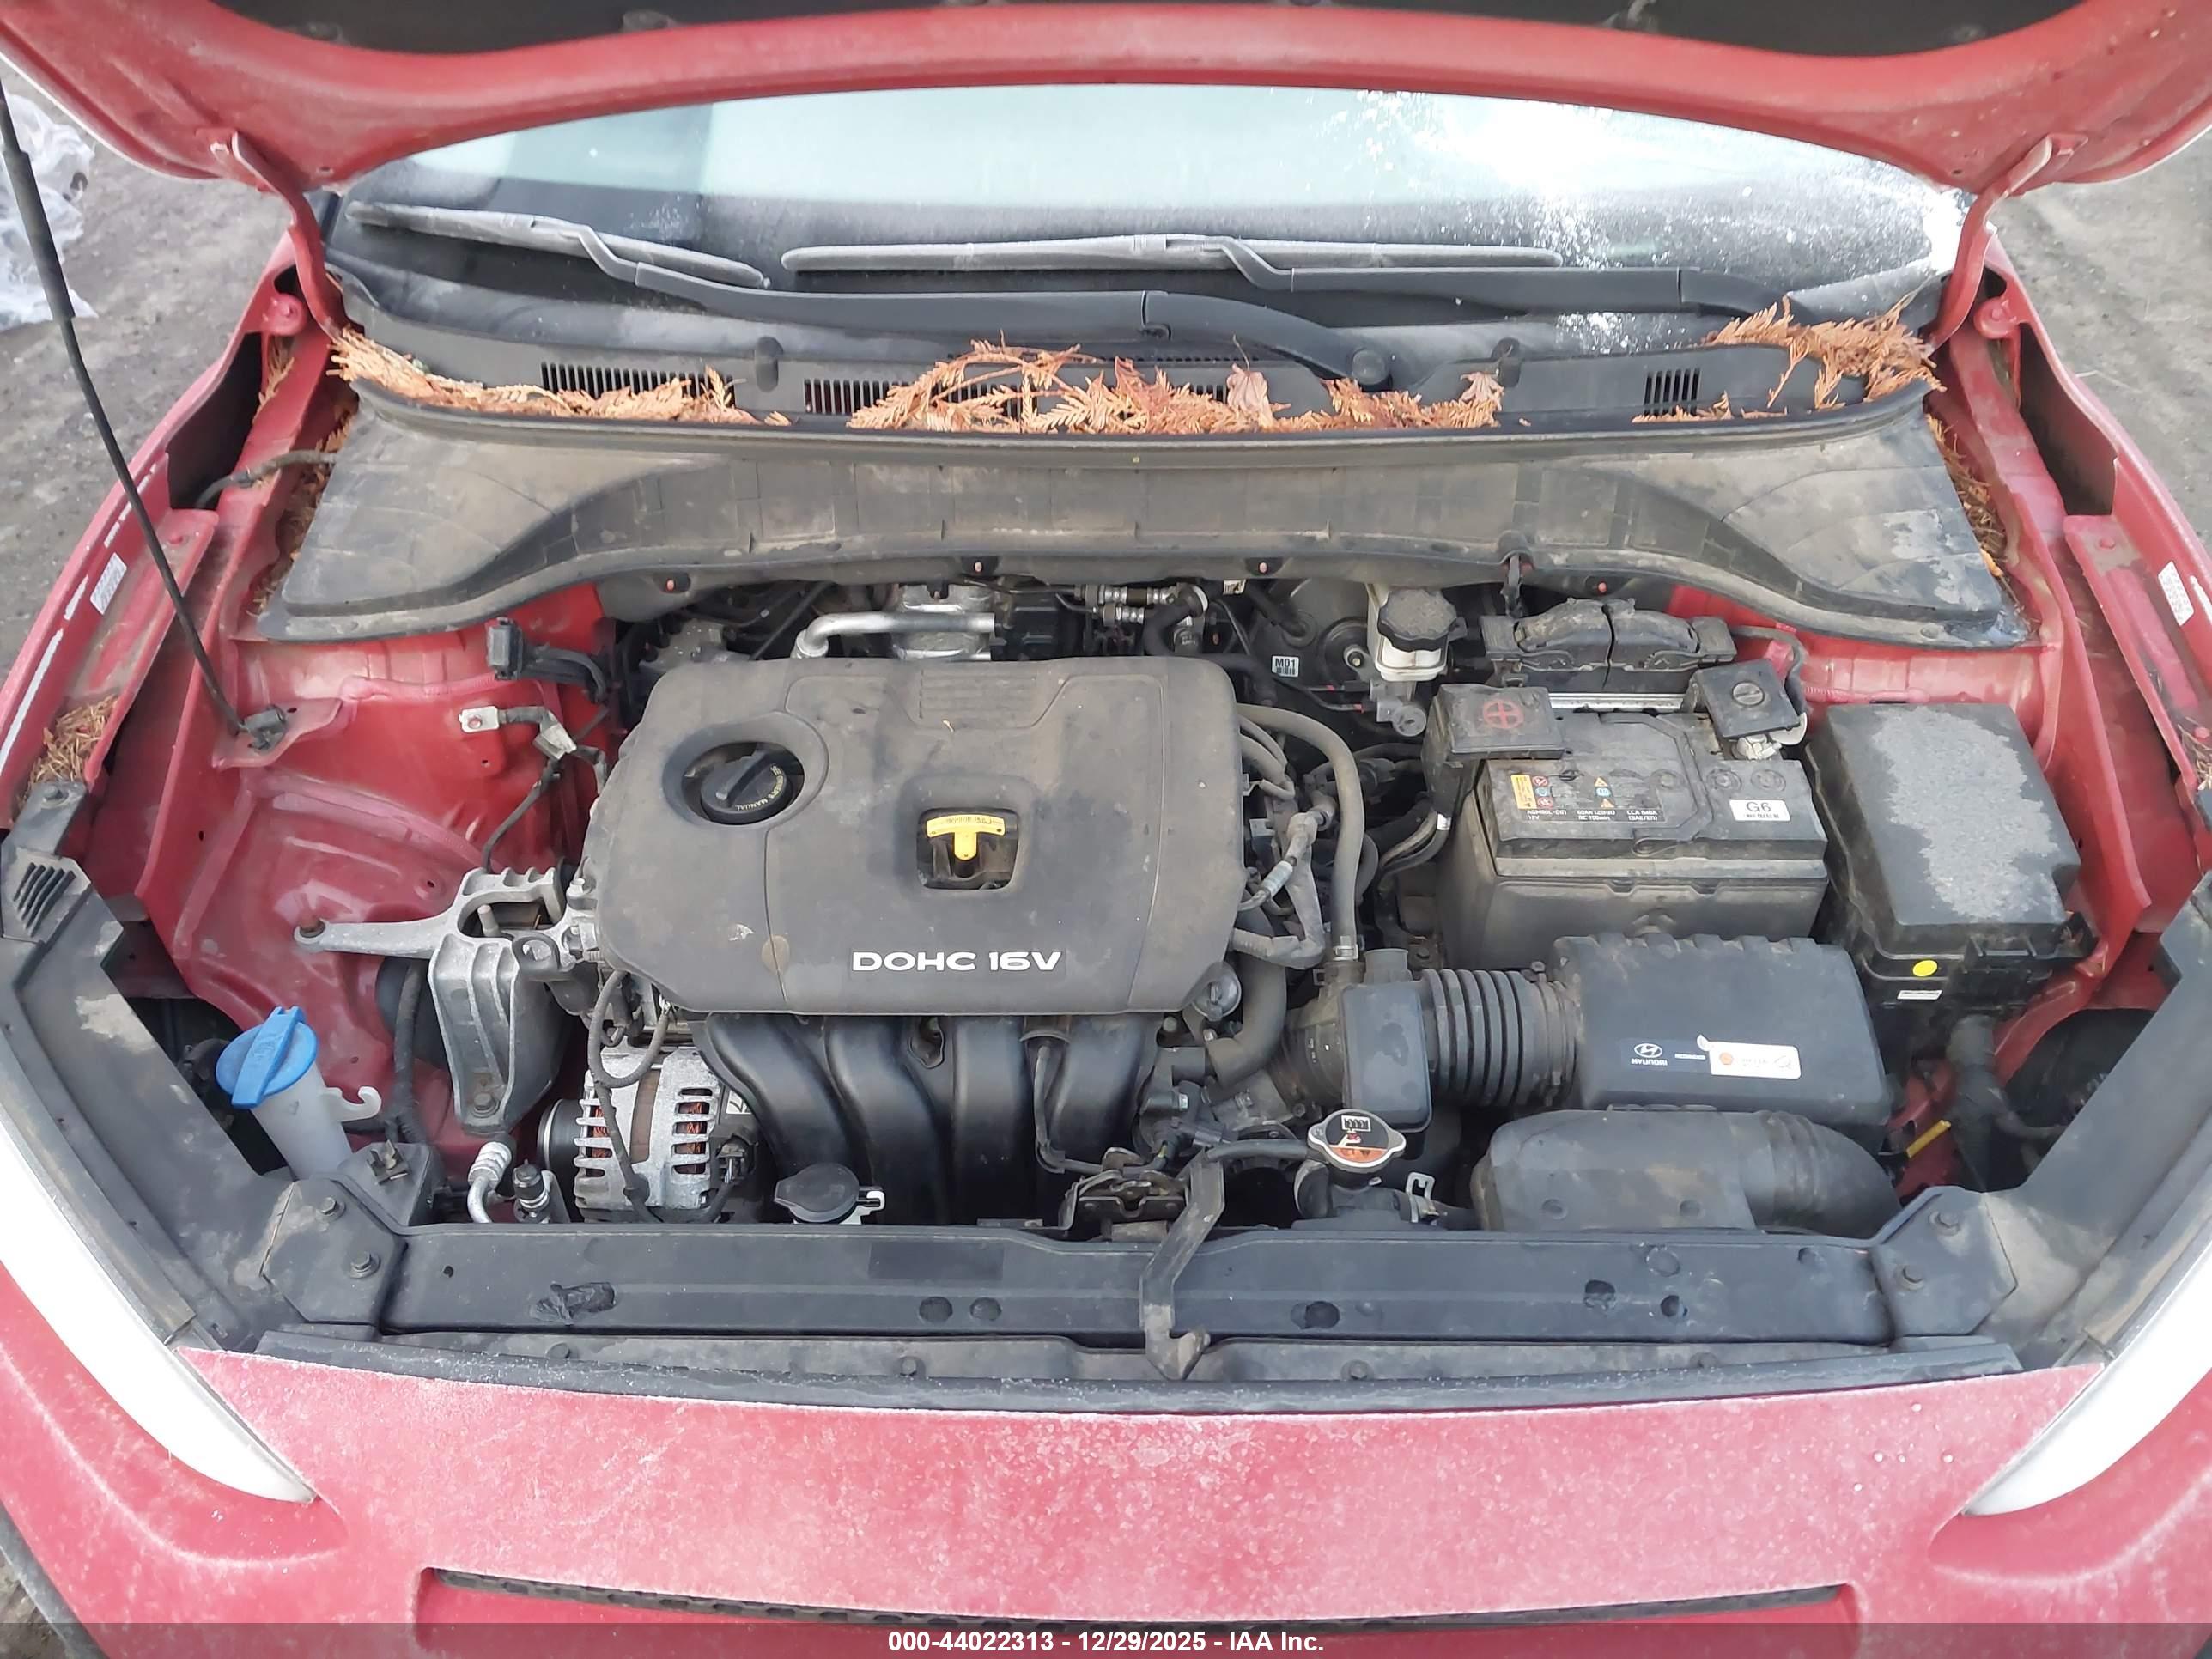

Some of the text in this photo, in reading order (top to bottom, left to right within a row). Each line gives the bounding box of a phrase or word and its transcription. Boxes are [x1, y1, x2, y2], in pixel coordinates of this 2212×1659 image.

[1275, 658, 1296, 667] M01
[735, 798, 769, 811] MANUAL
[1746, 801, 1771, 812] G6
[853, 951, 1061, 971] DOHC 16V
[1631, 1058, 1668, 1066] HYUNDAI
